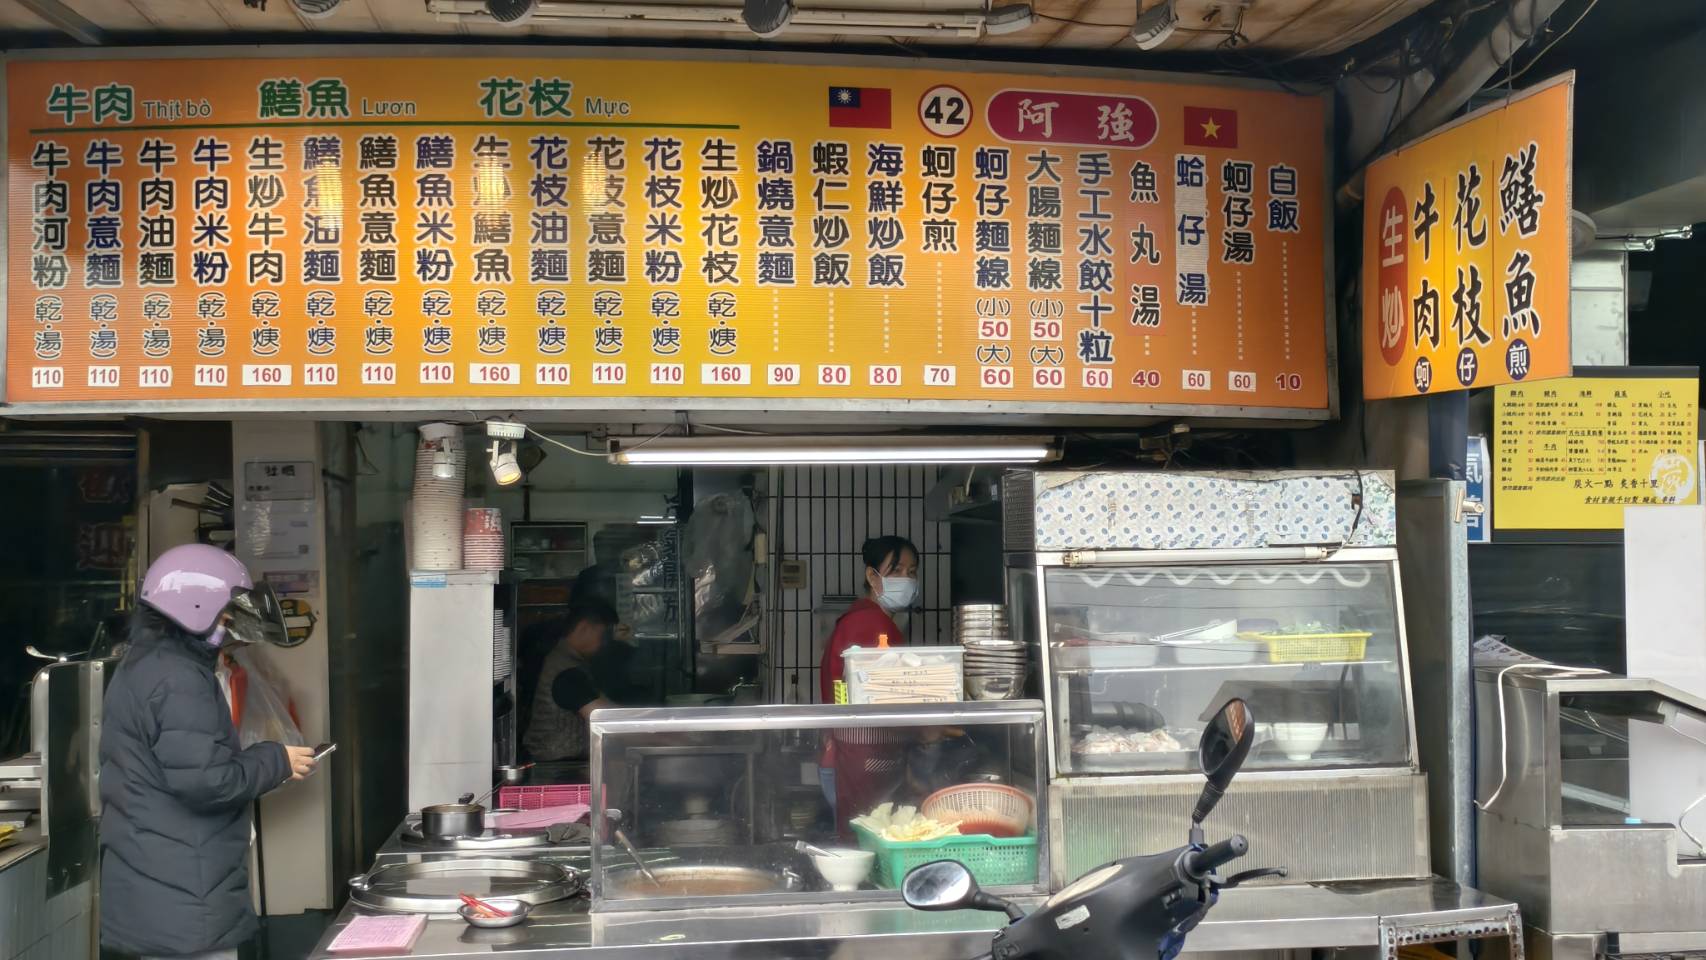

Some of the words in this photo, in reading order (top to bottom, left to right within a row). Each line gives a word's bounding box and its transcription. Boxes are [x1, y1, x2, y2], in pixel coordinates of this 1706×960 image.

[48, 84, 134, 123] 牛肉
[259, 79, 349, 118] 鱔魚
[480, 78, 572, 117] 花枝
[585, 98, 630, 116] Mực
[143, 101, 182, 120] Thịt
[186, 101, 211, 117] bò
[362, 99, 416, 116] Lươn
[923, 97, 965, 126] 42
[1017, 99, 1136, 143] 阿強
[922, 147, 957, 252] 蚵仔煎
[1268, 165, 1298, 231] 白飯
[32, 142, 68, 288] 牛肉河粉
[86, 141, 121, 287] 牛肉意麵
[139, 140, 174, 285] 牛肉油麵
[194, 138, 229, 284] 牛肉米粉
[248, 137, 284, 283] 生炒牛肉
[360, 135, 396, 282] 鱔魚意麵
[416, 135, 453, 281] 鱔魚米粉
[530, 137, 568, 281] 花枝油麵
[644, 138, 682, 282] 花枝米粉
[701, 139, 739, 284] 生炒花枝
[757, 141, 794, 284] 鍋燒意麵
[812, 142, 850, 285] 蝦仁炒飯
[867, 144, 904, 287] 海鮮炒飯
[1222, 161, 1254, 263] 蚵仔湯
[975, 147, 1010, 289] 蚵仔麵線
[1027, 151, 1062, 289] 大腸麵線
[1177, 156, 1207, 303] 蛤仔湯
[1130, 162, 1160, 327] 魚丸湯
[1500, 145, 1543, 338] 鱔魚
[1077, 153, 1114, 363] 手工水餃十粒
[1414, 182, 1440, 349] 牛肉
[1452, 166, 1490, 346] 花枝
[1382, 206, 1404, 349] 生炒
[977, 298, 1011, 317] (小)
[1029, 298, 1063, 317] (小)
[981, 321, 1008, 337] 50
[1033, 321, 1060, 338] 50
[977, 345, 1011, 364] (大)
[1029, 346, 1063, 365] (大)
[34, 369, 61, 384] 110
[90, 368, 118, 383] 110
[141, 368, 168, 383] 110
[197, 367, 225, 382] 110
[252, 367, 281, 382] 160
[307, 367, 335, 381] 110
[364, 366, 393, 381] 110
[422, 365, 451, 380] 110
[479, 366, 510, 381] 160
[538, 366, 567, 381] 110
[594, 366, 625, 381] 110
[652, 366, 681, 381] 110
[711, 367, 741, 381] 160
[774, 367, 794, 381] 90
[822, 367, 847, 382] 80
[873, 368, 898, 384] 80
[930, 368, 949, 384] 70
[983, 369, 1011, 385] 60
[1035, 369, 1062, 385] 60
[1085, 370, 1109, 386] 60
[1132, 370, 1160, 387] 40
[1188, 373, 1205, 388] 60
[1234, 374, 1251, 389] 60
[1276, 374, 1301, 390] 10
